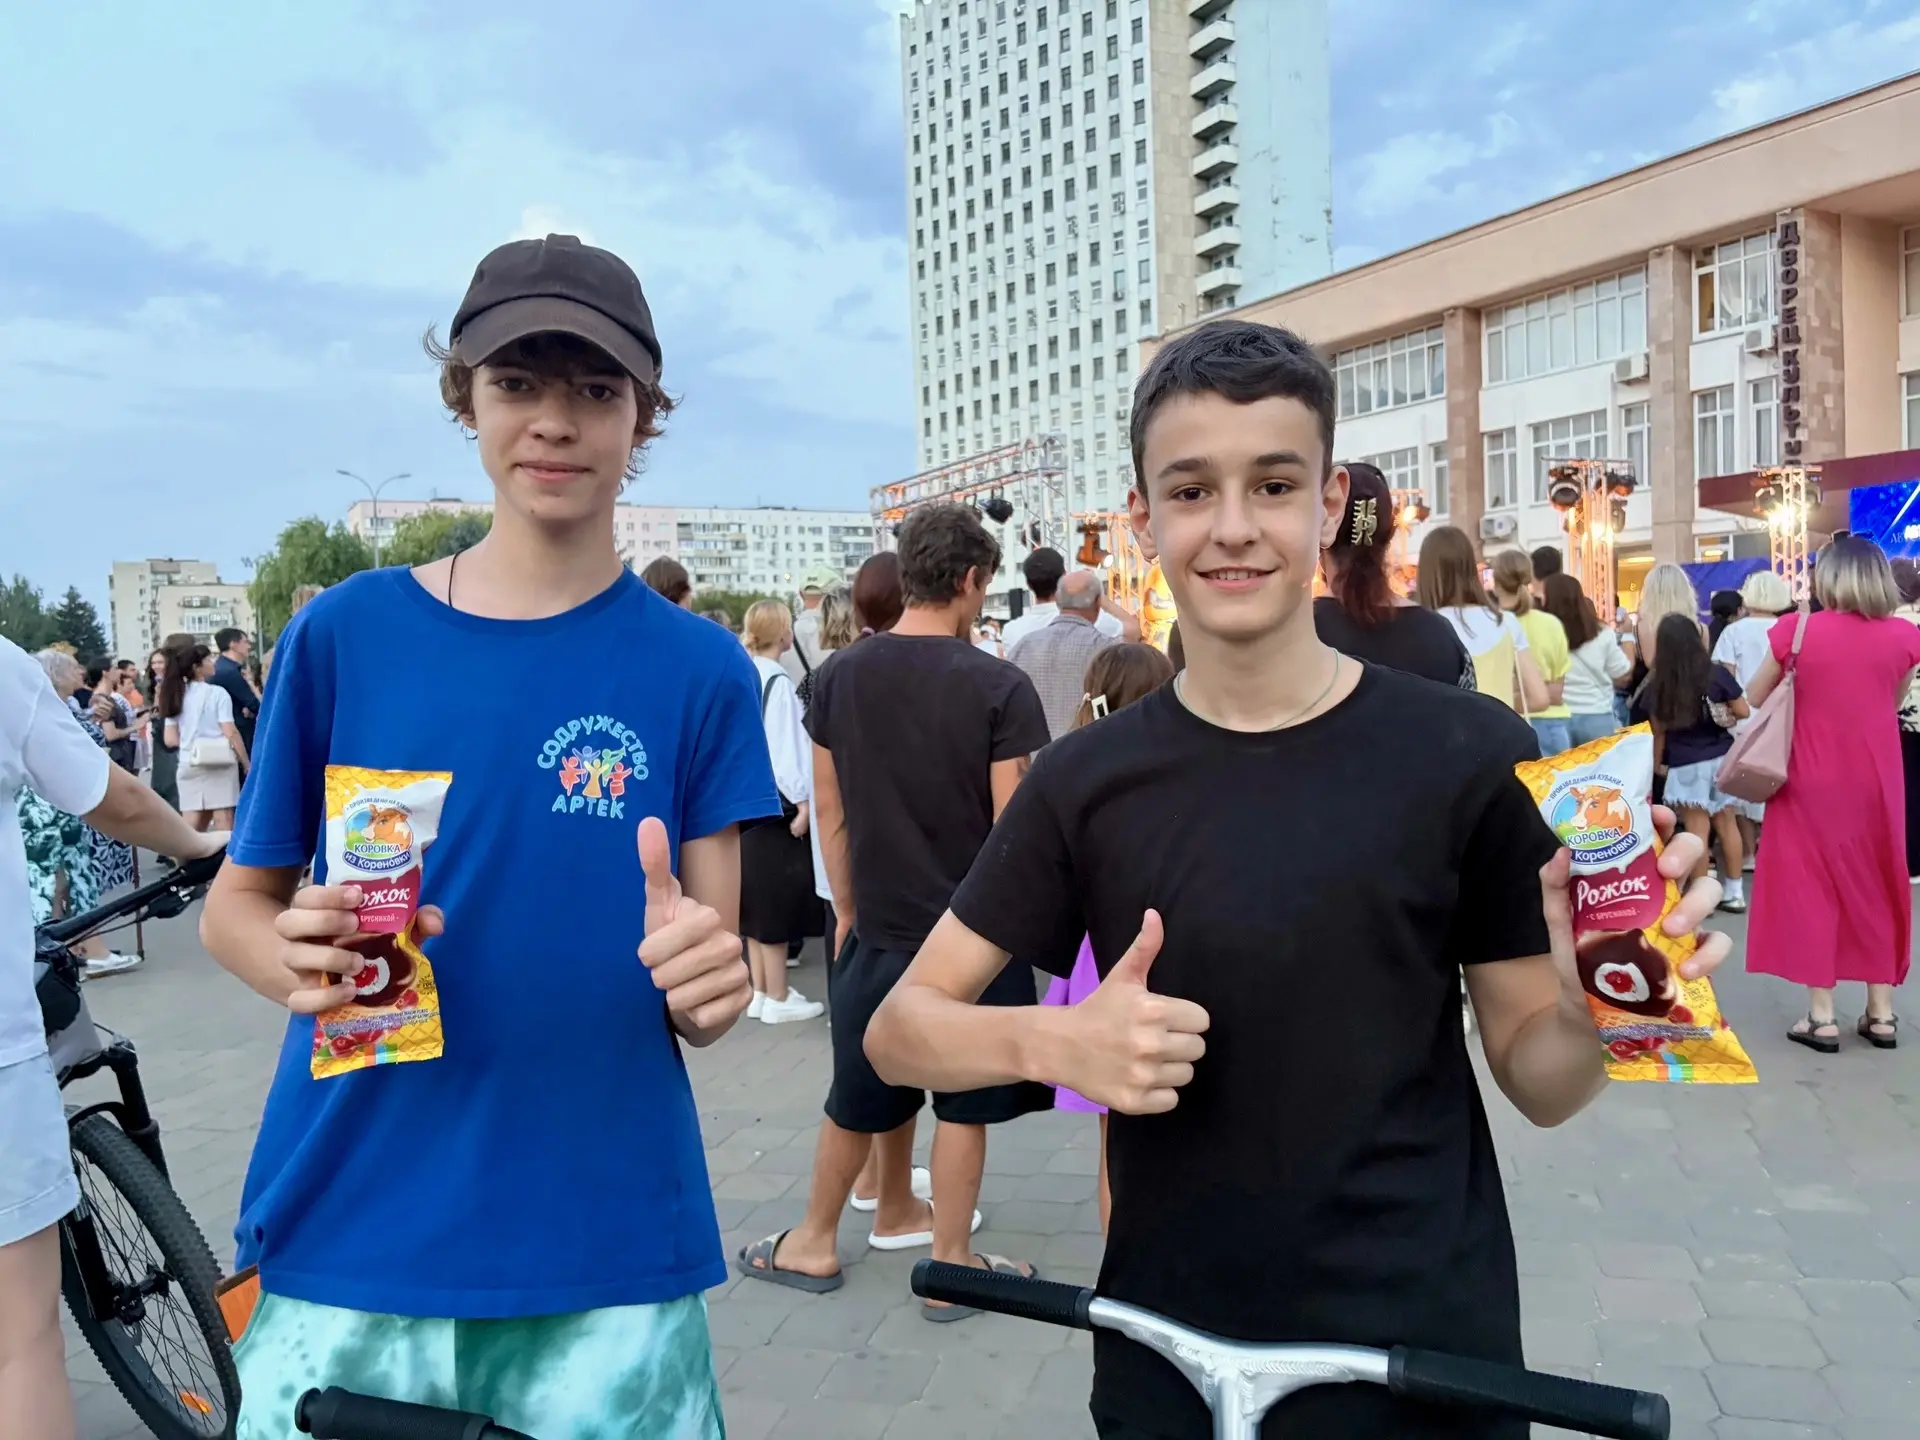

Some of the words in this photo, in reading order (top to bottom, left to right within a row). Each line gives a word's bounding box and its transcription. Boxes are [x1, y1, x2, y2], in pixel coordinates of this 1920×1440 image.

[1777, 220, 1802, 345] ДВОРЕЦ
[537, 714, 649, 780] СОДРУЖЕСТВО
[551, 794, 625, 820] АРТЕК
[354, 844, 401, 853] КОРОВКА
[1566, 827, 1622, 847] КОРОВКА
[345, 852, 357, 864] из
[355, 884, 412, 907] ожок
[1577, 875, 1650, 912] Рожок
